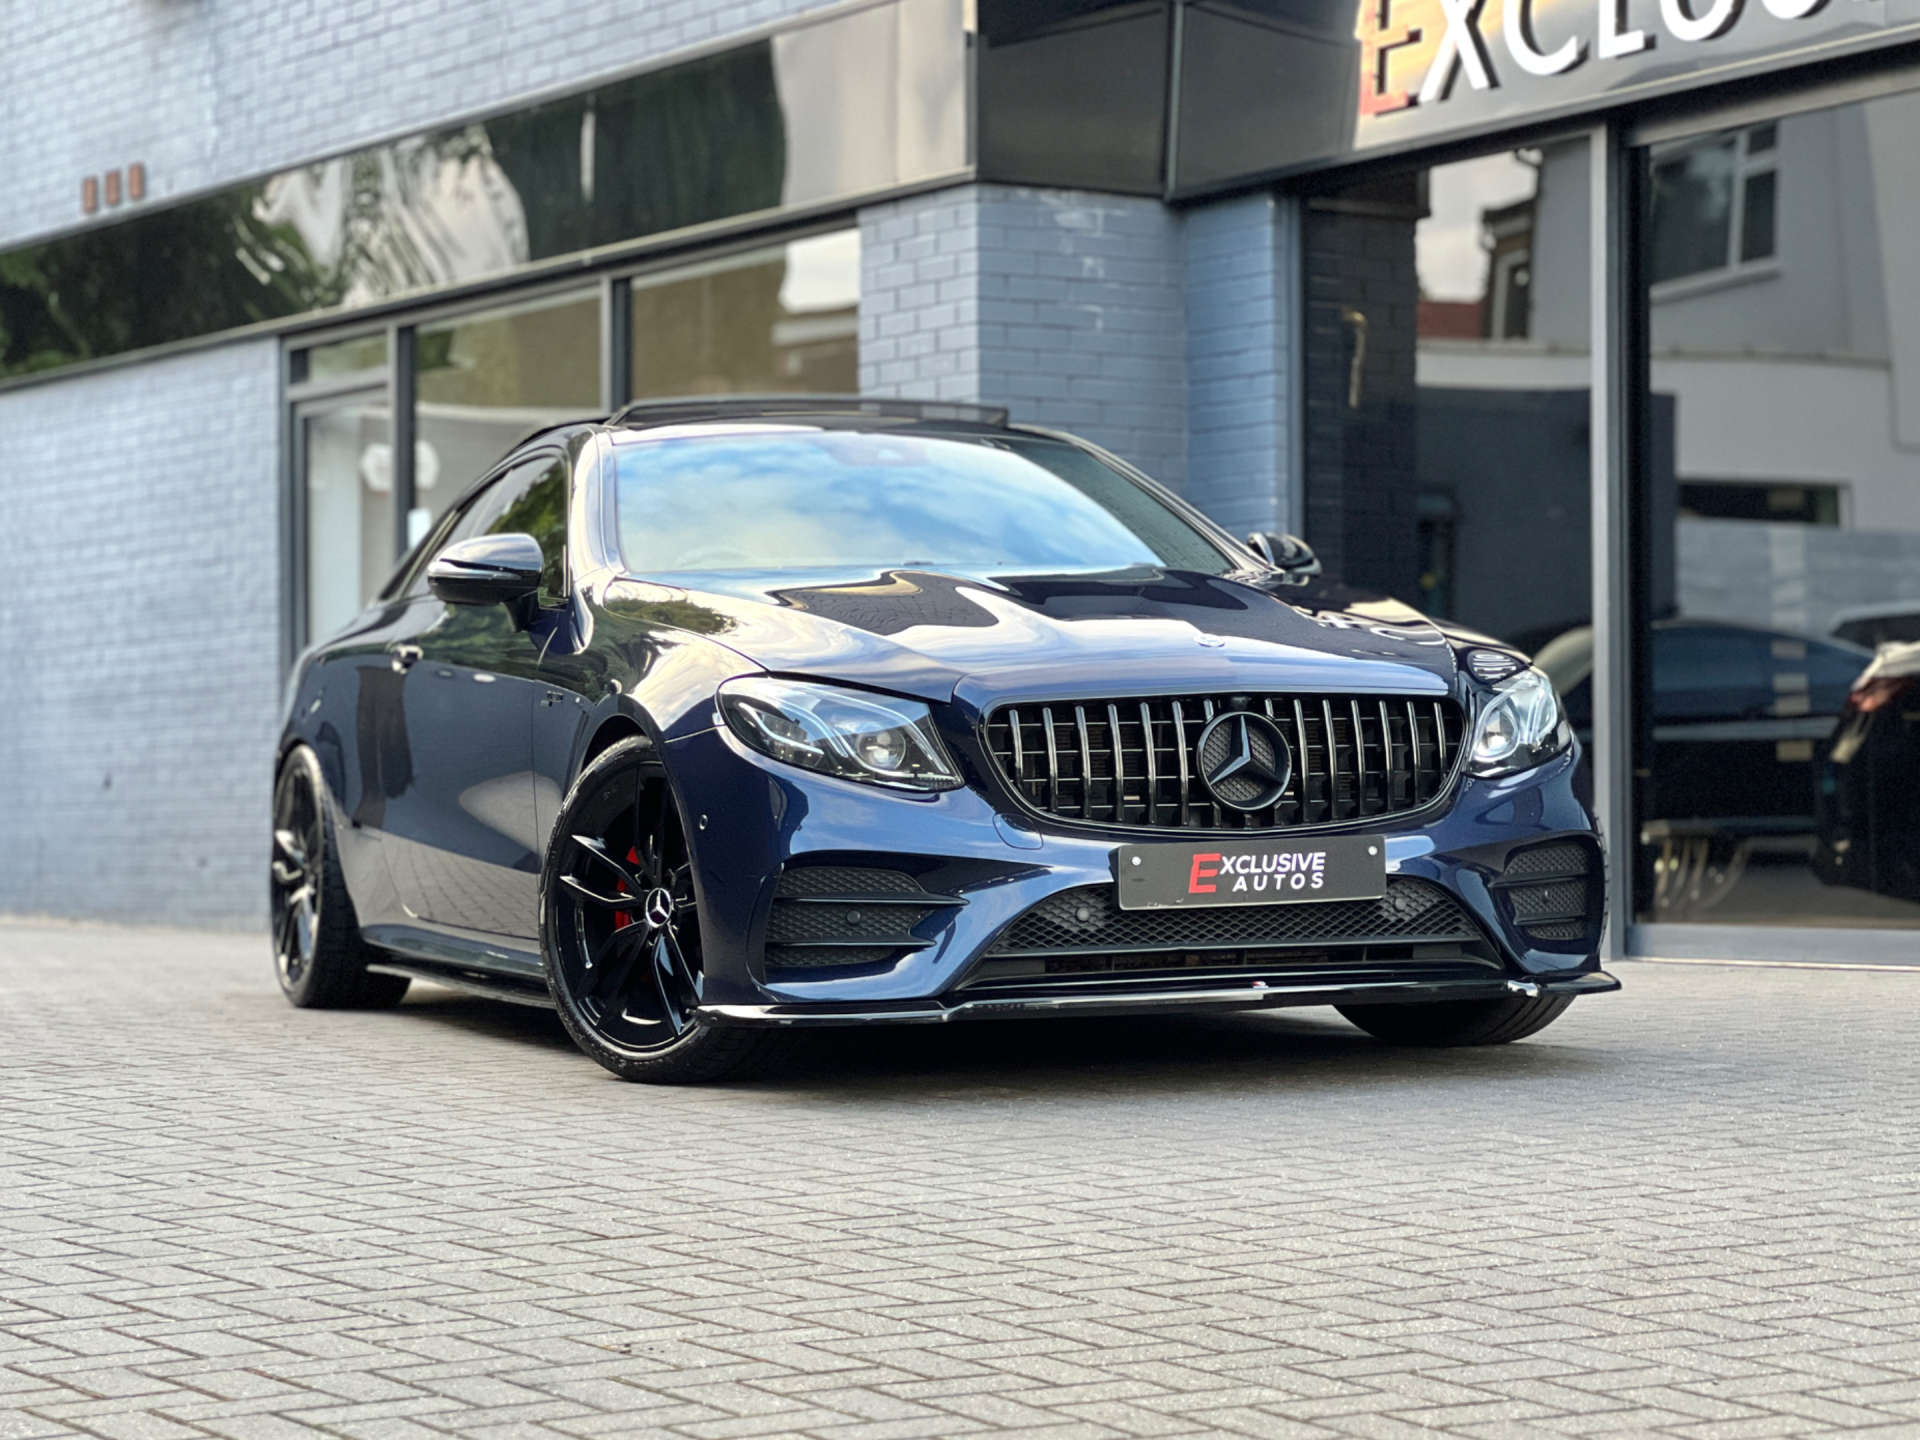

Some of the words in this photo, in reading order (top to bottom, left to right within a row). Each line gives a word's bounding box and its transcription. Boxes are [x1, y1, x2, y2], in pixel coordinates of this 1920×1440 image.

[1357, 0, 1822, 115] EXCL
[1189, 853, 1326, 893] EXCLUSIVE
[1232, 873, 1324, 892] AUTOS
